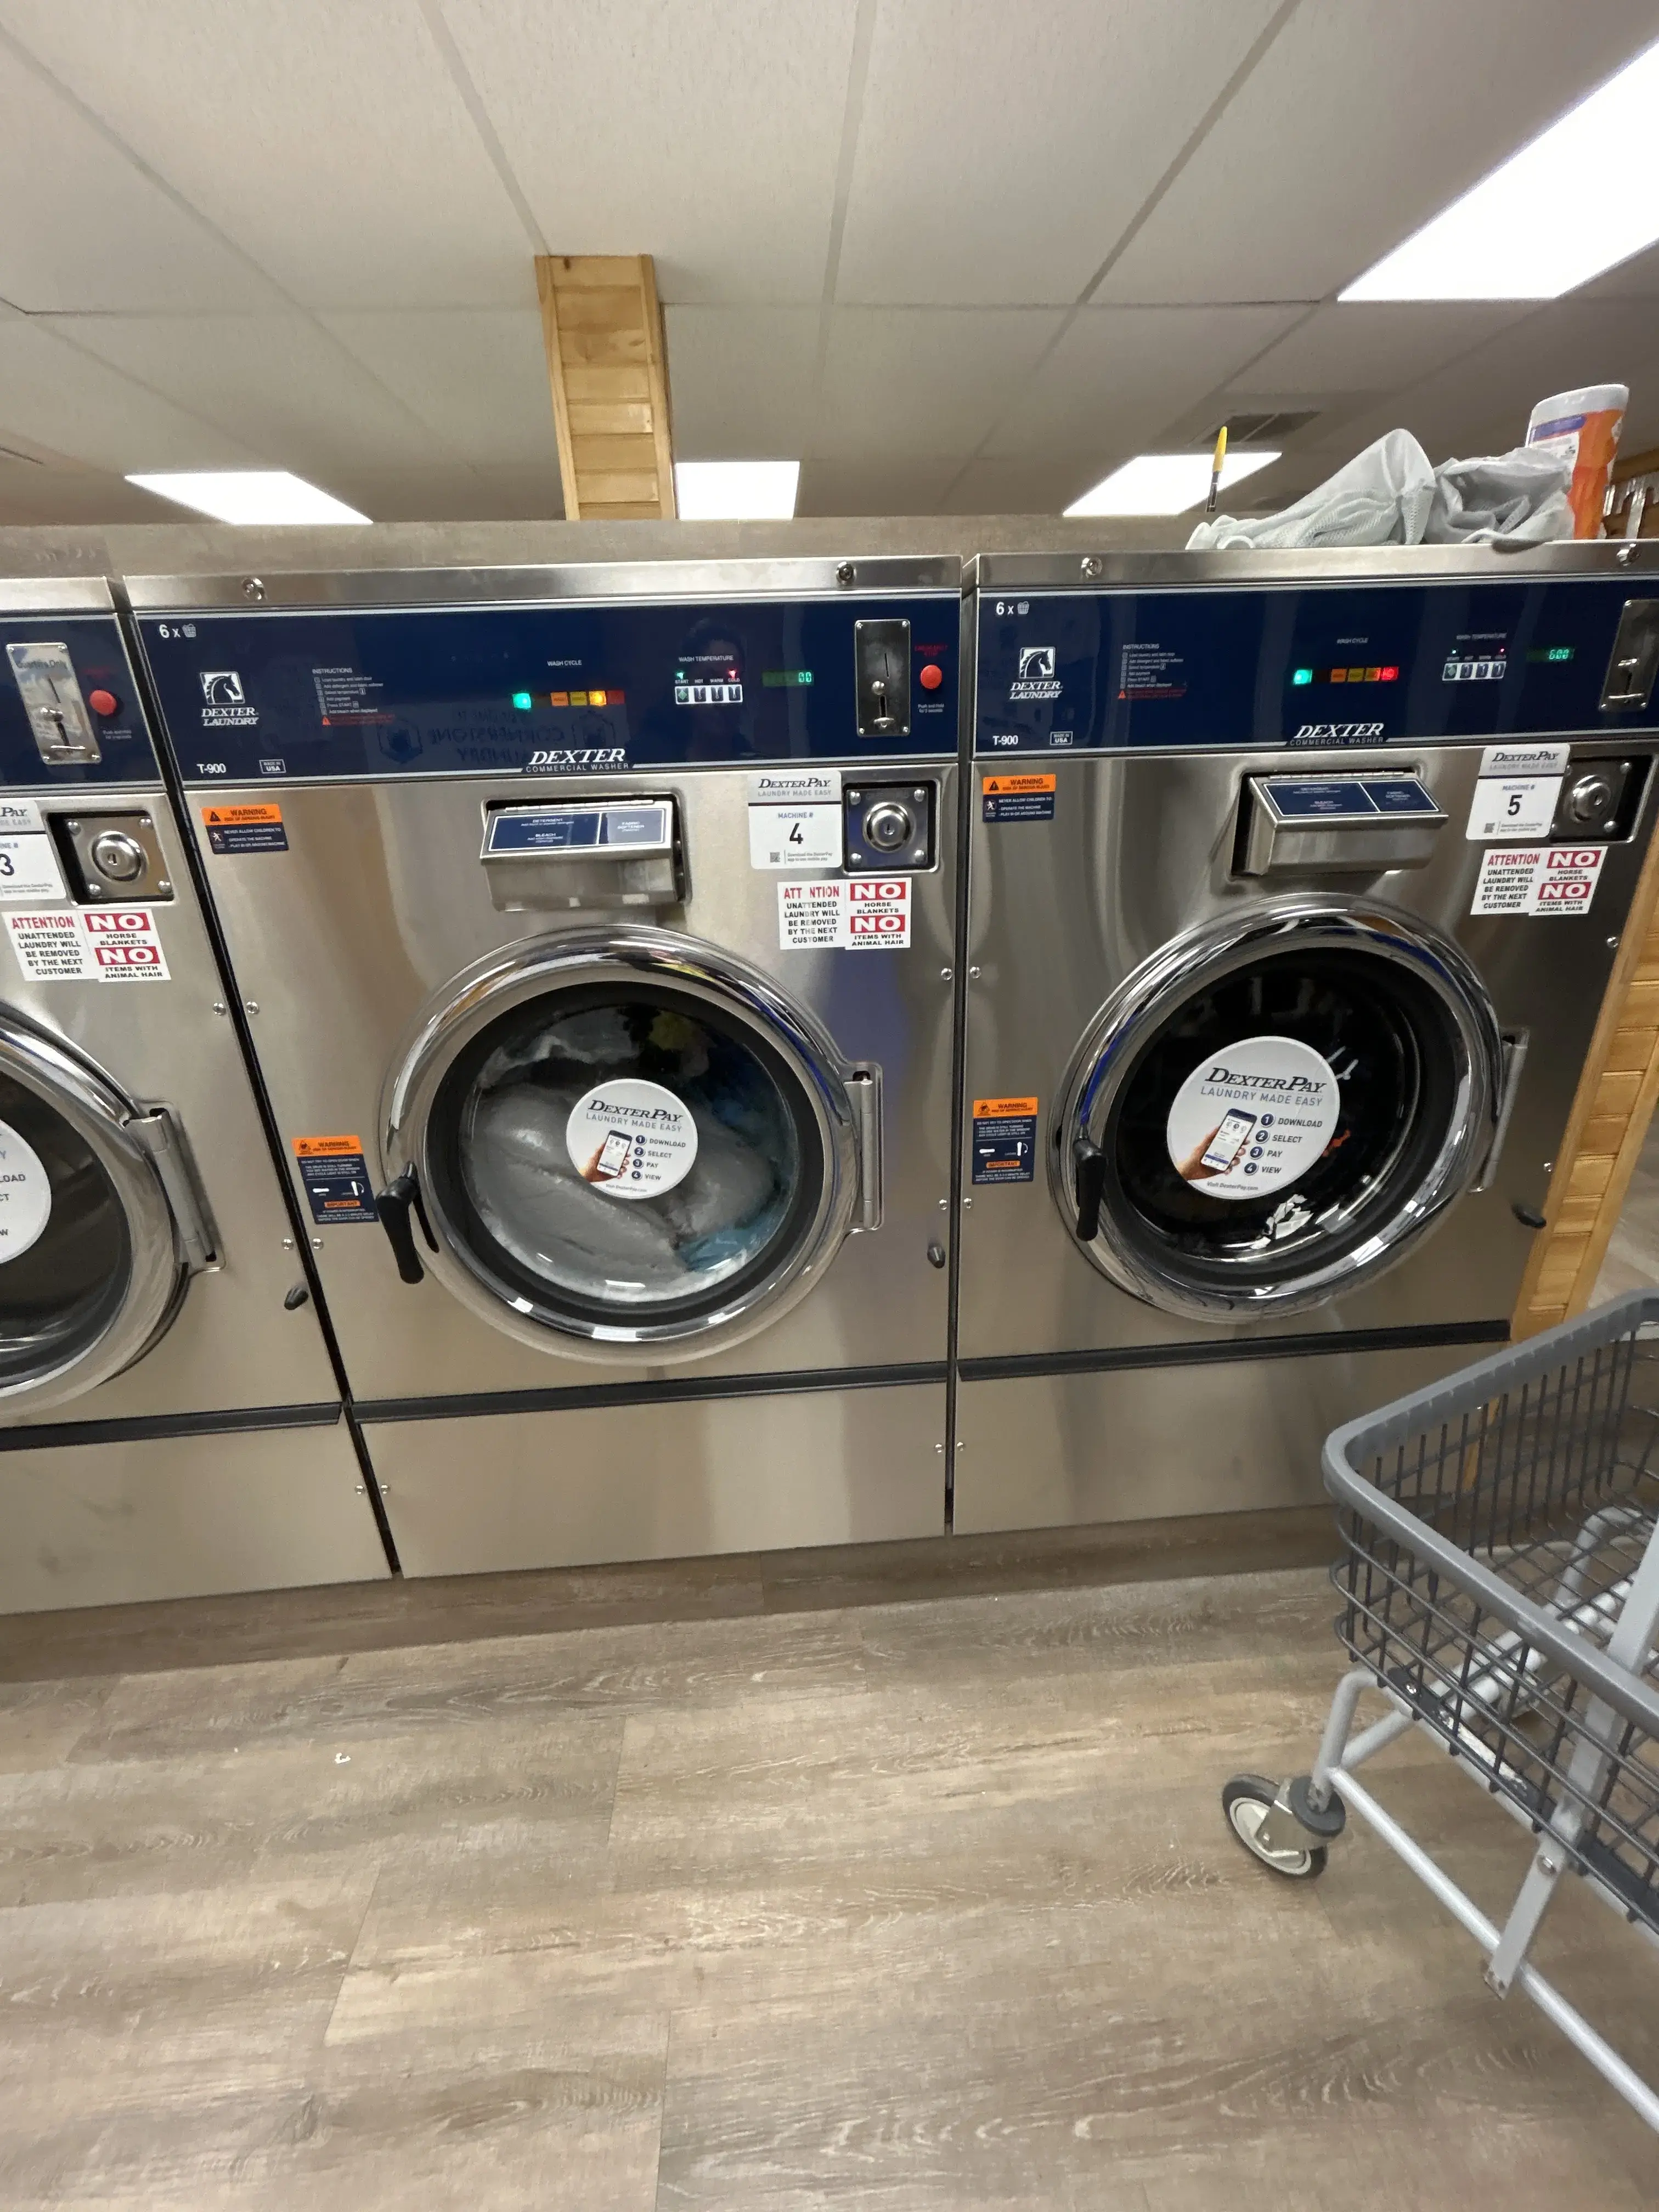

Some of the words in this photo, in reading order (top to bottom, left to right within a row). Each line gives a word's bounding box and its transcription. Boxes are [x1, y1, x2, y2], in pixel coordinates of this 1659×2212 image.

[996, 601, 1005, 616] 6
[1007, 605, 1014, 614] x
[159, 624, 170, 639] 6
[1011, 681, 1061, 691] DEXTER
[1009, 691, 1062, 699] LAUNDRY
[201, 707, 256, 717] DEXTER
[203, 717, 259, 726] LAUNDRY
[1294, 723, 1385, 738] DEXTER
[992, 735, 1019, 746] T-900
[529, 748, 625, 765] DEXTER
[196, 763, 226, 774] T-900
[1508, 795, 1522, 815] 5
[789, 823, 803, 844] 4
[0, 854, 14, 876] 3
[1488, 854, 1540, 865] ATTENTION
[1551, 852, 1595, 867] NO
[855, 884, 902, 899] NO
[1542, 883, 1587, 898] NO
[12, 916, 75, 929] ATTENTION
[89, 914, 144, 930] NO
[855, 916, 901, 932] NO
[99, 947, 154, 963] NO
[1201, 1086, 1256, 1101] LAUNDRY
[1260, 1093, 1291, 1104] MADE
[1295, 1096, 1323, 1107] EASY
[586, 1112, 628, 1125] LAUNDRY
[631, 1120, 656, 1129] MADE
[660, 1124, 682, 1132] EASY
[1278, 1118, 1323, 1128] DOWNLOAD
[649, 1138, 686, 1148] DOWNLOAD
[1272, 1135, 1302, 1143] SELECT
[647, 1150, 672, 1159] SELECT
[1219, 1182, 1259, 1191] DexterPay.com
